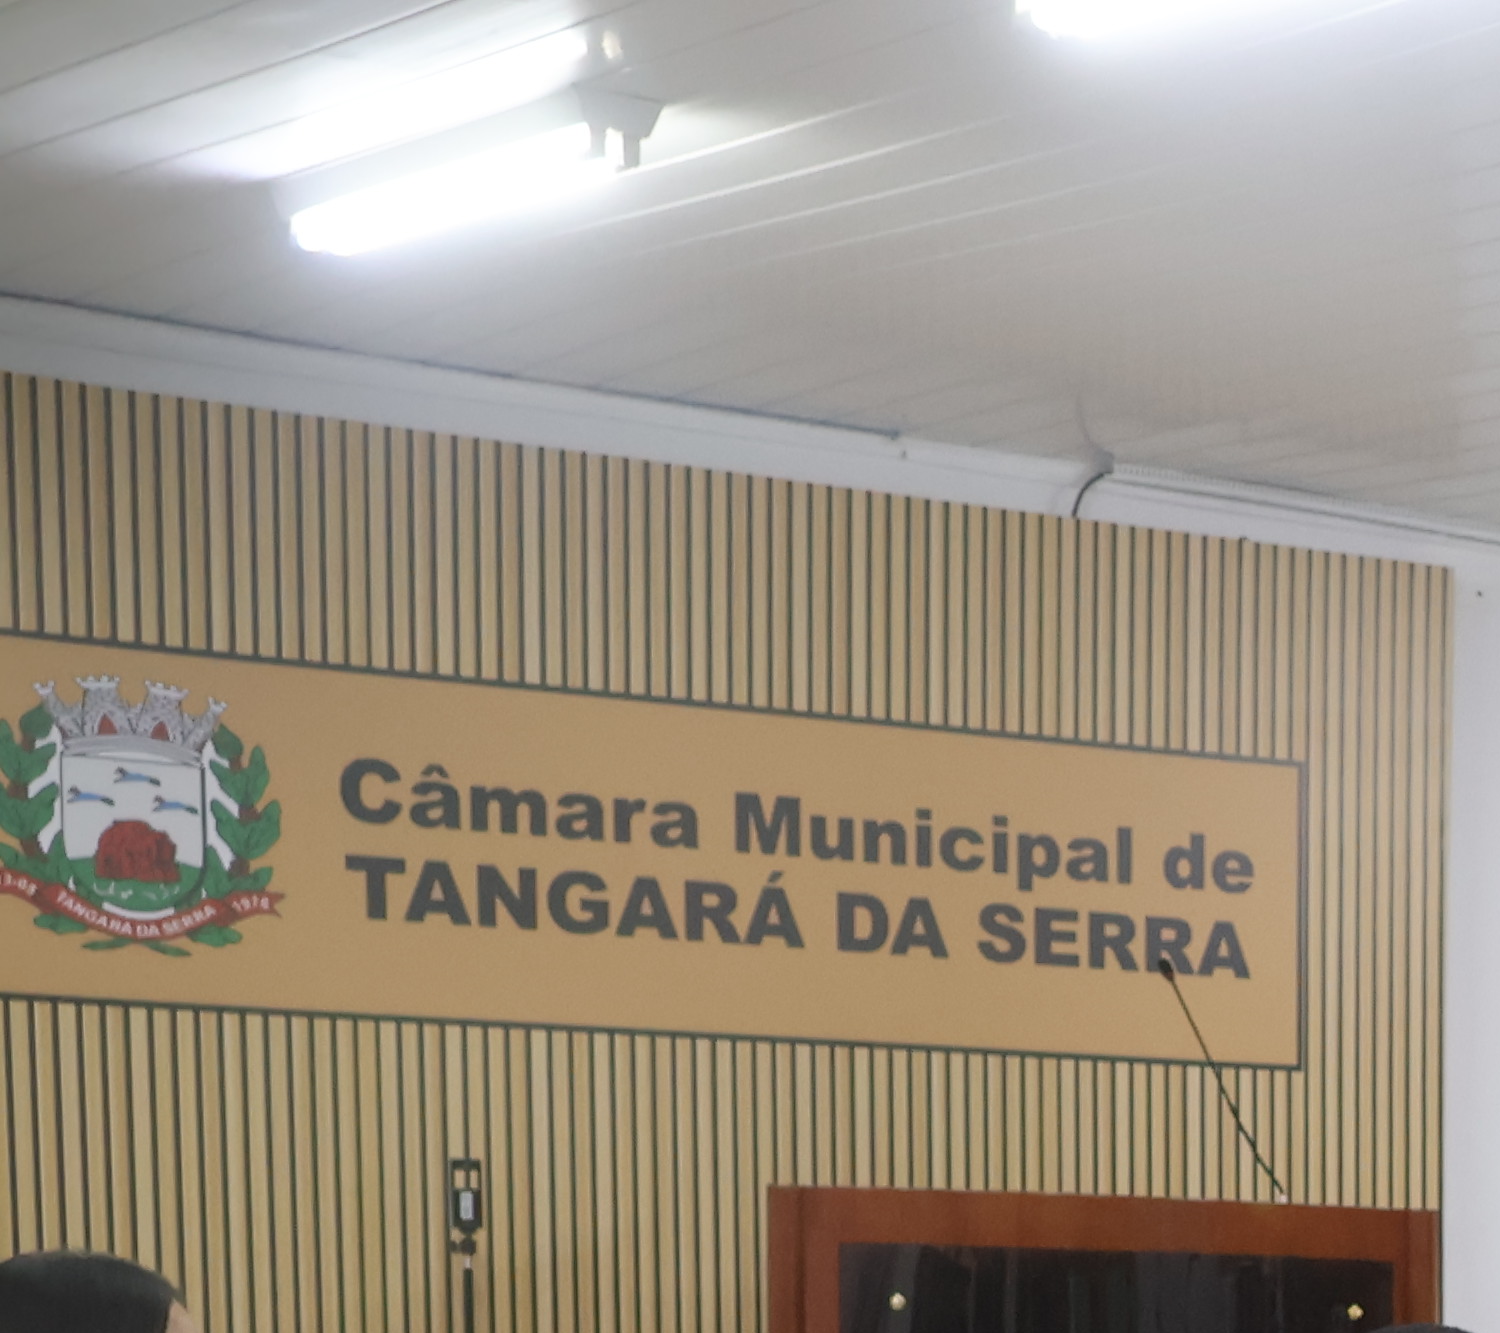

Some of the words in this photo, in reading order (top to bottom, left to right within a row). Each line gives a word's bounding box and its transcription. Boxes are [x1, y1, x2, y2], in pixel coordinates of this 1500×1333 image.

[340, 757, 699, 849] Câmara
[735, 793, 1132, 891] Municipal
[1163, 834, 1255, 894] de
[345, 852, 804, 949] TANGARÁ
[836, 893, 949, 959] DA
[977, 904, 1251, 979] SERRA
